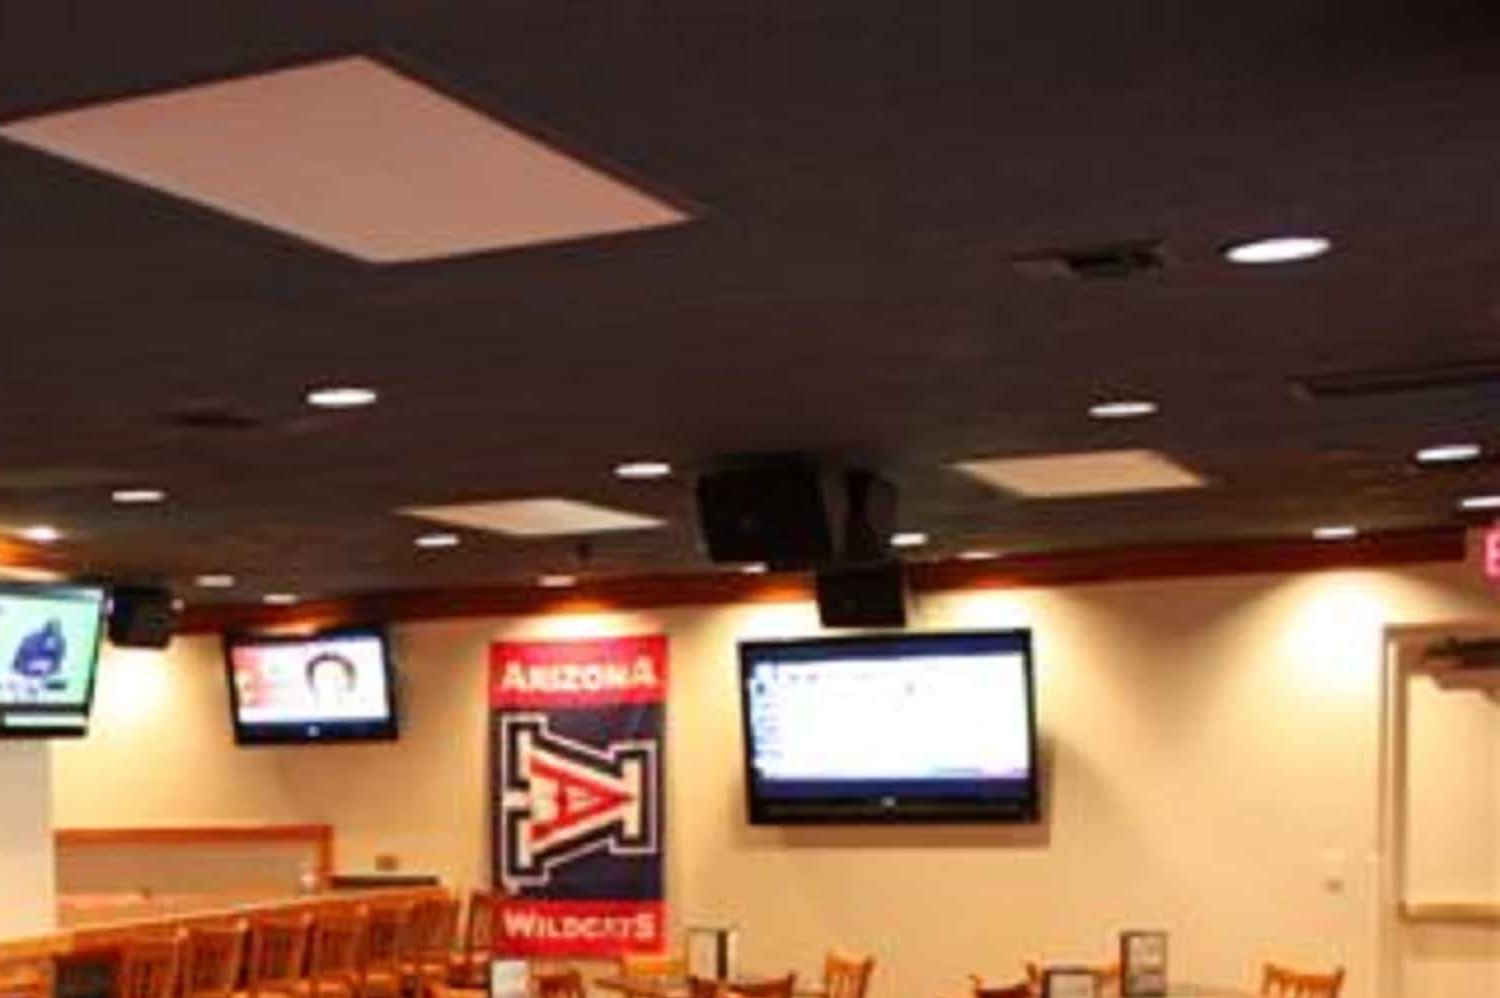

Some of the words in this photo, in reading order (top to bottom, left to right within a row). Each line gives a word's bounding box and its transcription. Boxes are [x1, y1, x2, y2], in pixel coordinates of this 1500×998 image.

[501, 656, 656, 692] ARIZONA
[502, 714, 657, 885] A
[503, 908, 655, 941] WILDCATS
